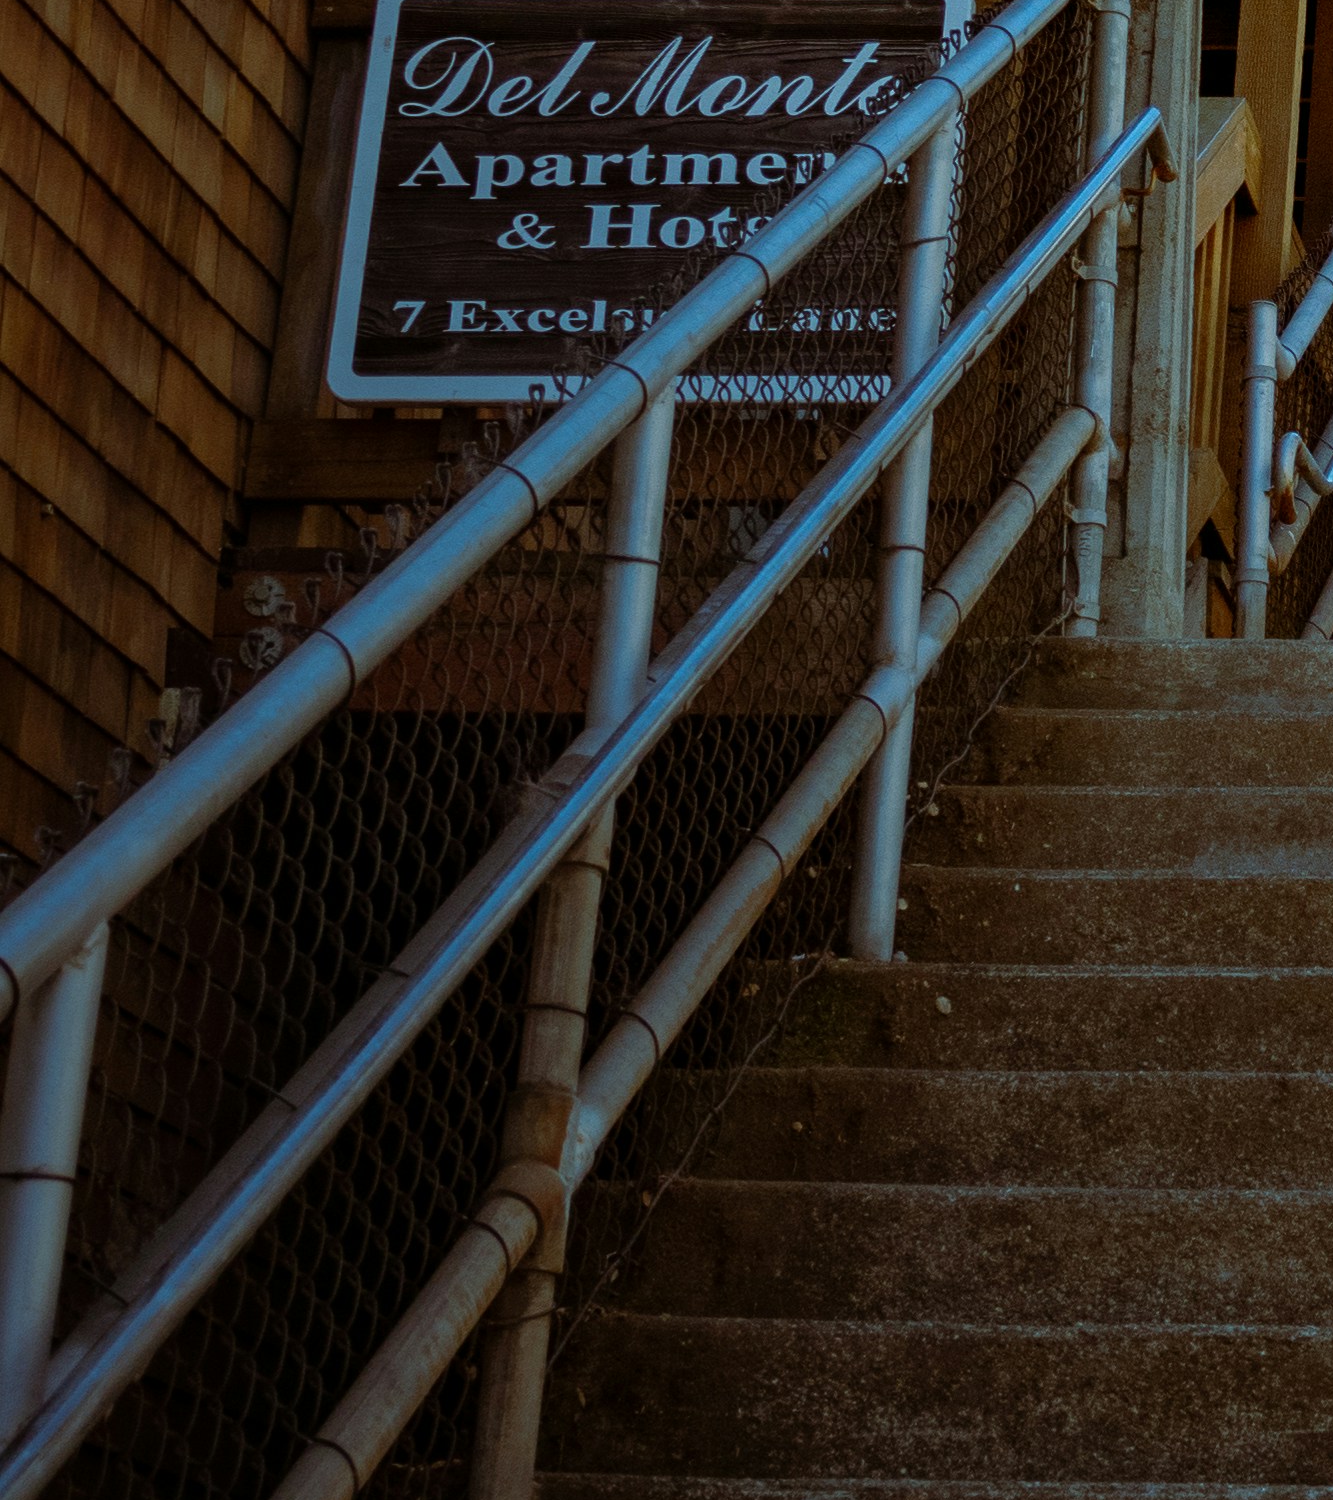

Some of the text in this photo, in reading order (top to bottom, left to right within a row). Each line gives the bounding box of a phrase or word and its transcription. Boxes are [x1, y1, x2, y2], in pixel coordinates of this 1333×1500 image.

[398, 36, 597, 117] Del
[398, 141, 909, 200] Apartmen
[496, 213, 557, 250] &
[392, 300, 427, 334] 7
